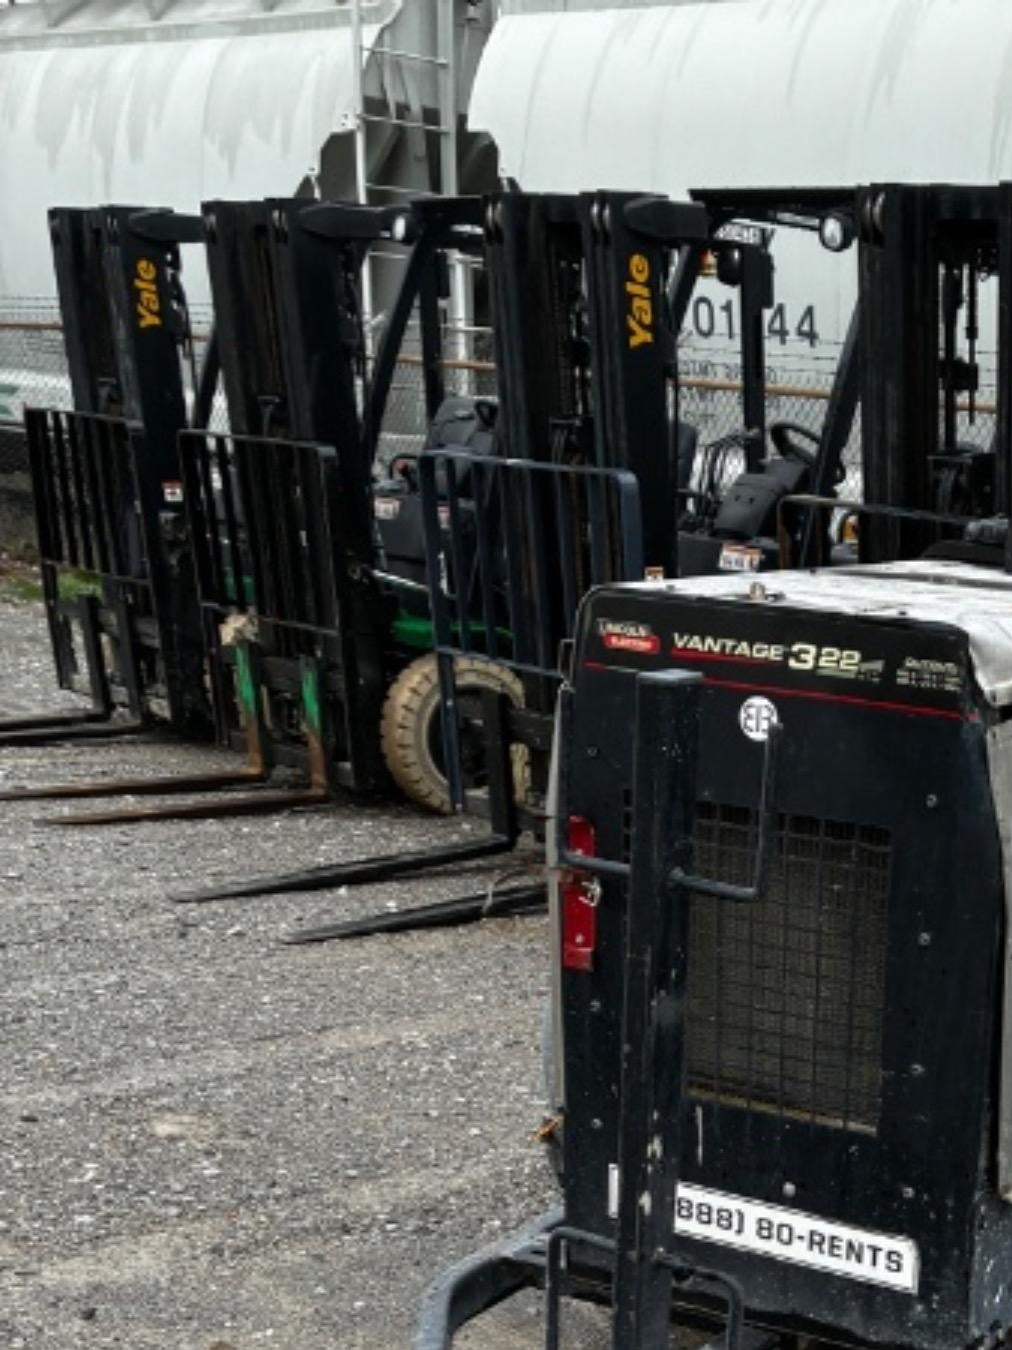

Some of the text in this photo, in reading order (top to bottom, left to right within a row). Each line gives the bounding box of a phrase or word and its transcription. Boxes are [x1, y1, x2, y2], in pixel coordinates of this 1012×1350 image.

[134, 259, 162, 328] Yale
[625, 254, 654, 349] Yale
[673, 632, 785, 661] VANTAGE
[787, 642, 862, 673] 322
[755, 1216, 904, 1273] 80-RENTS
